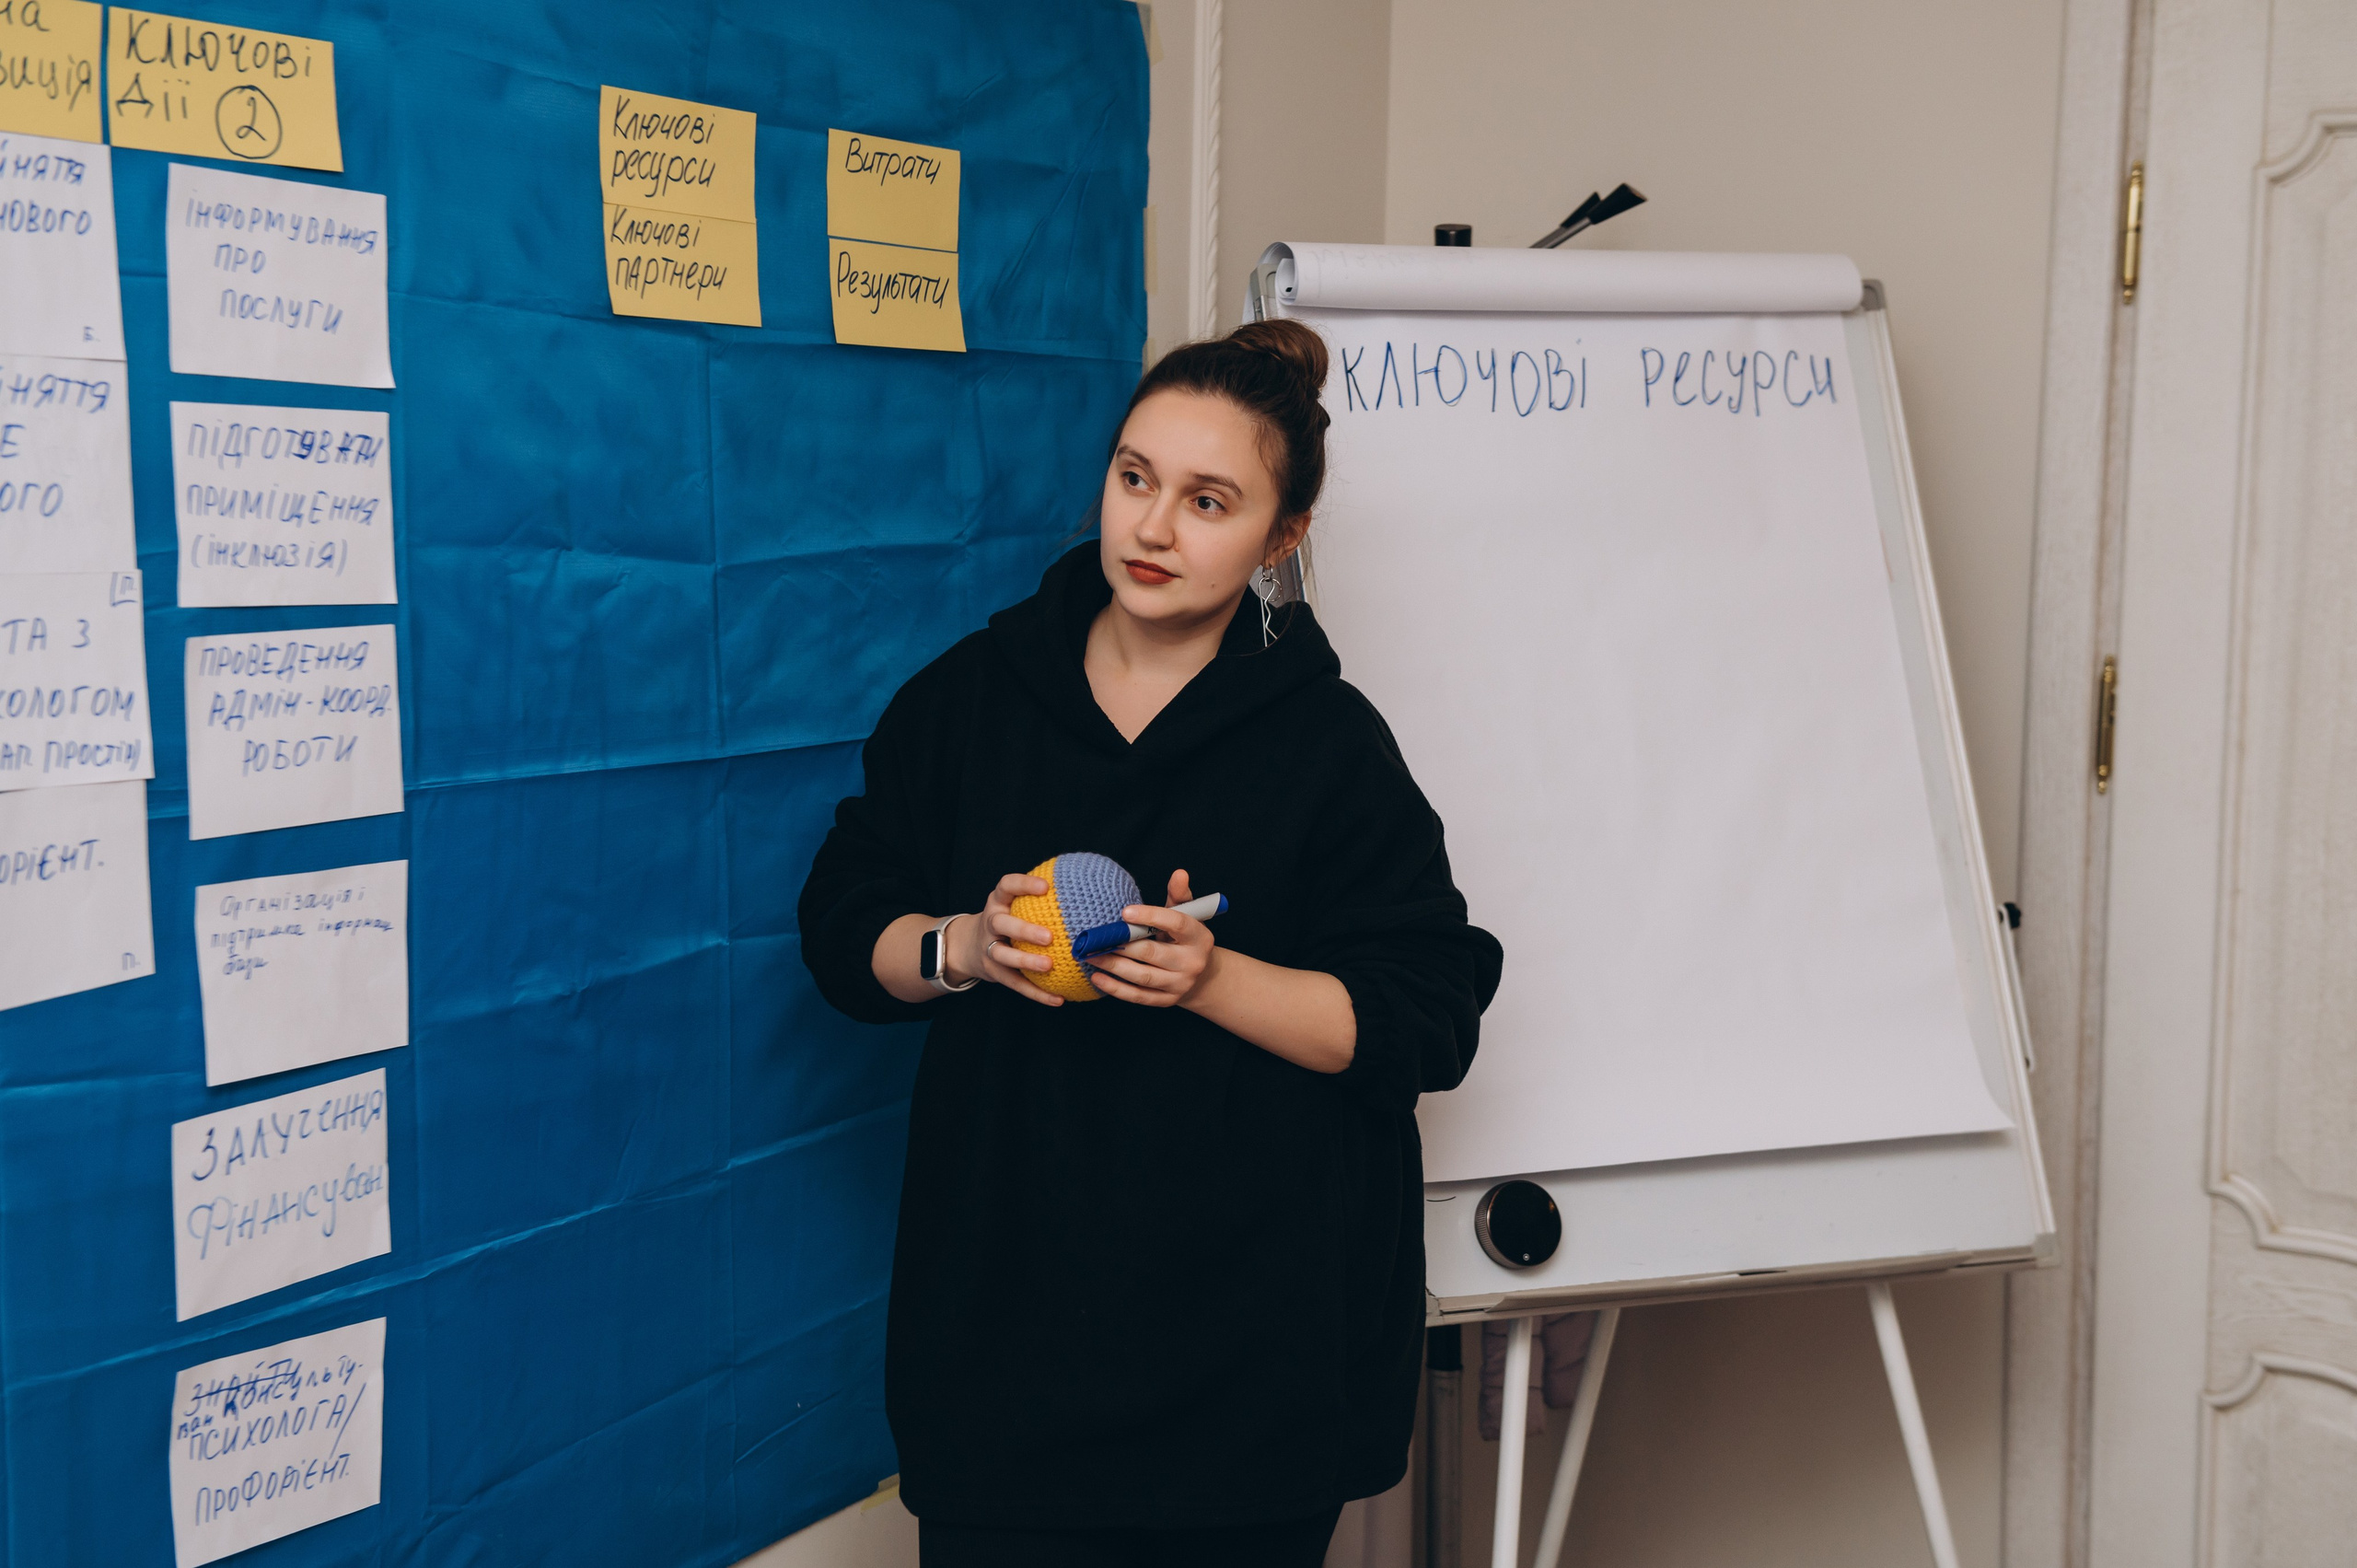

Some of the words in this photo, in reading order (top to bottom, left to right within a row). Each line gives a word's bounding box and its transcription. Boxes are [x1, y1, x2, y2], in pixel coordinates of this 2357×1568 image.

[613, 94, 716, 145] Ключові
[611, 148, 717, 198] ресурси
[845, 137, 942, 187] Витрати
[610, 204, 702, 249] Ключові
[213, 243, 267, 274] ПРО
[837, 250, 950, 314] Результати
[219, 288, 344, 336] ПОСЛУГИ
[186, 483, 381, 528] ПРИМІЩЕННЯ
[198, 641, 369, 683] ПРОВЕДЕННЯ
[242, 735, 358, 778] РОБОТИ
